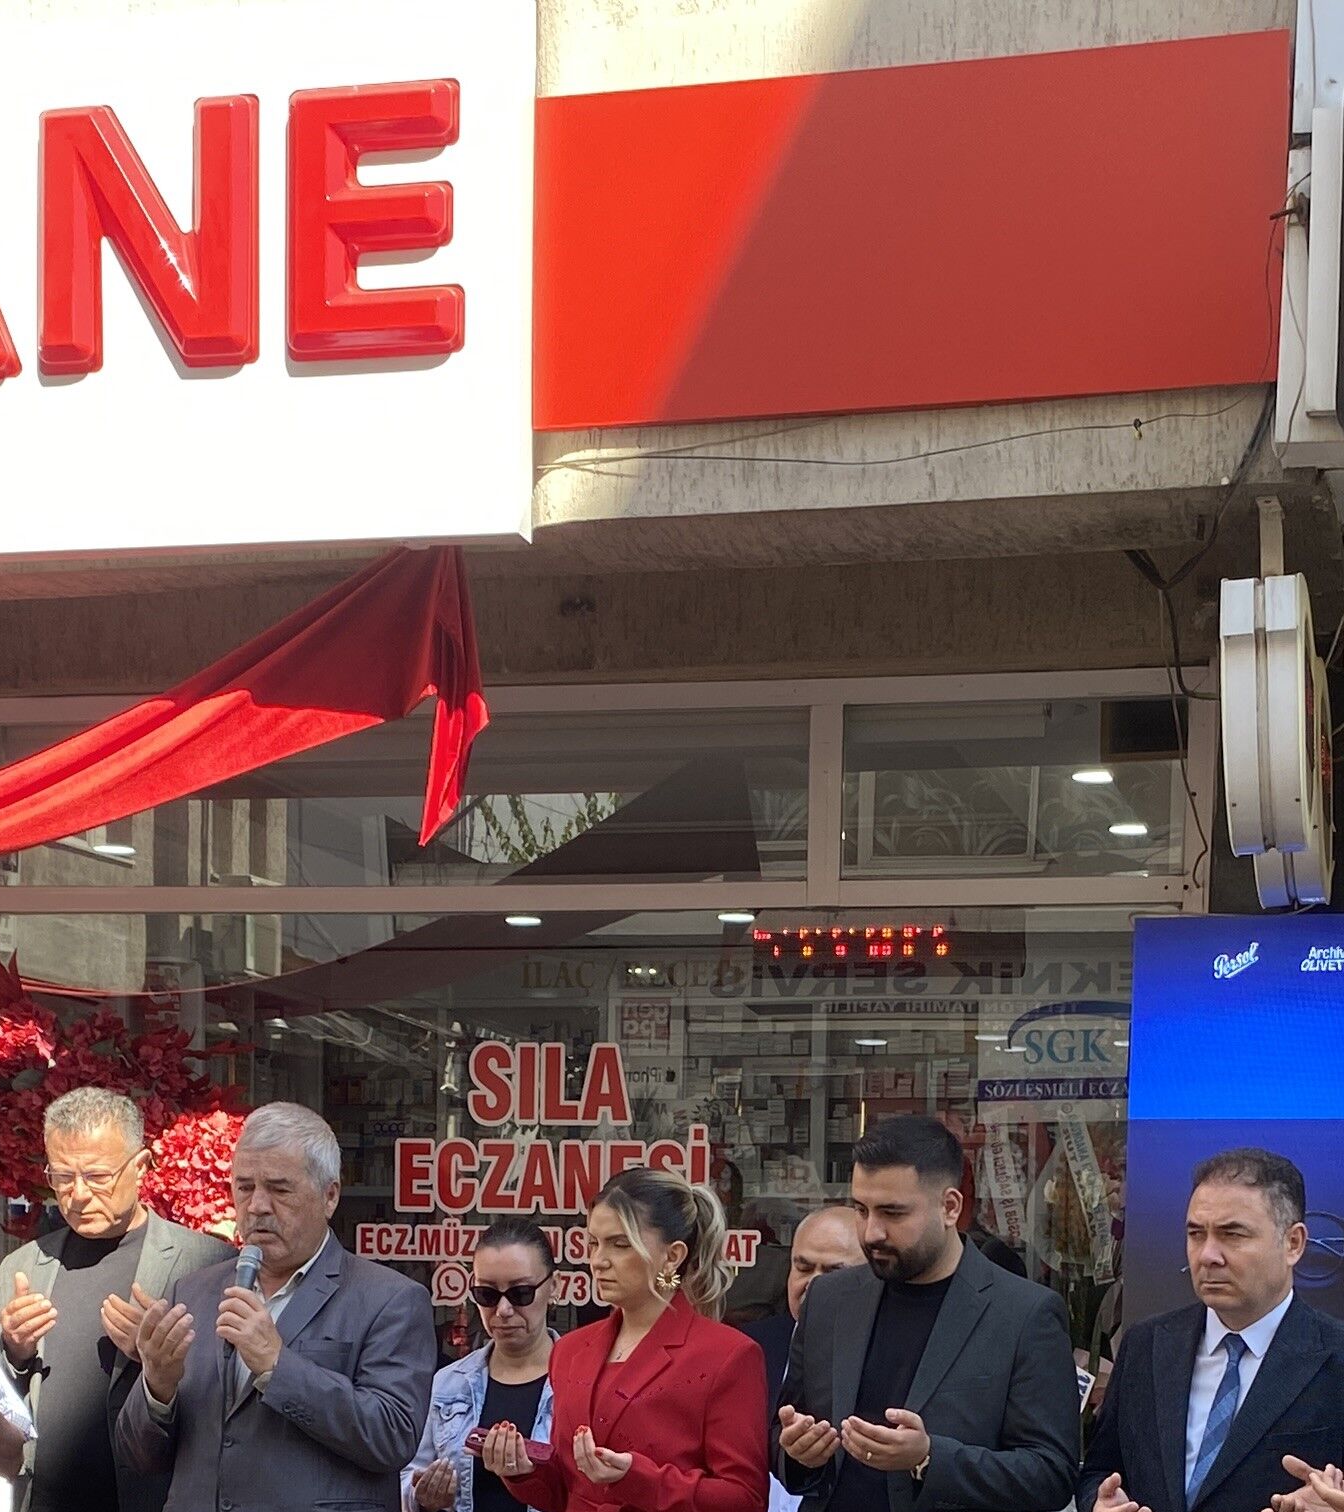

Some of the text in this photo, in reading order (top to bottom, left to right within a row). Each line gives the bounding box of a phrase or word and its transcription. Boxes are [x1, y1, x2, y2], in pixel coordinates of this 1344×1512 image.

[1213, 942, 1259, 979] Persol
[1024, 1029, 1111, 1064] SGK
[469, 1041, 631, 1125] SILA
[985, 1080, 1083, 1099] SÖZLEŞMELİ
